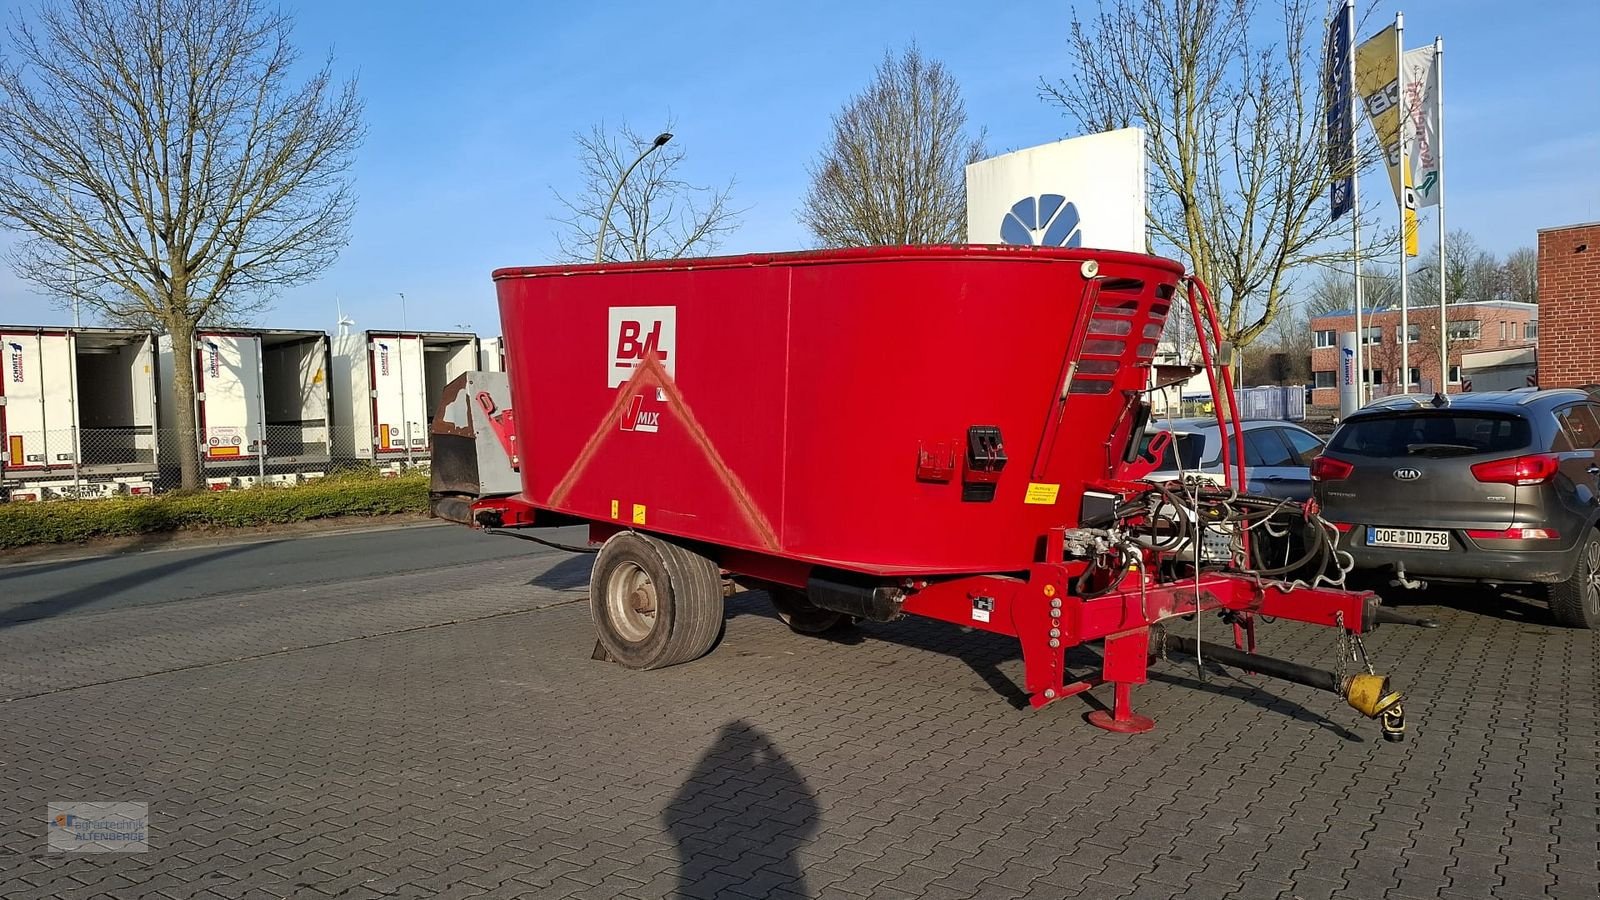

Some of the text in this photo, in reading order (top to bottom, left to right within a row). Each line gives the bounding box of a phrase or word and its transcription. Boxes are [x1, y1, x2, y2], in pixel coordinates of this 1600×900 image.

[636, 411, 660, 426] MIX
[1397, 469, 1417, 478] KIA
[1375, 529, 1448, 546] COE DD 758
